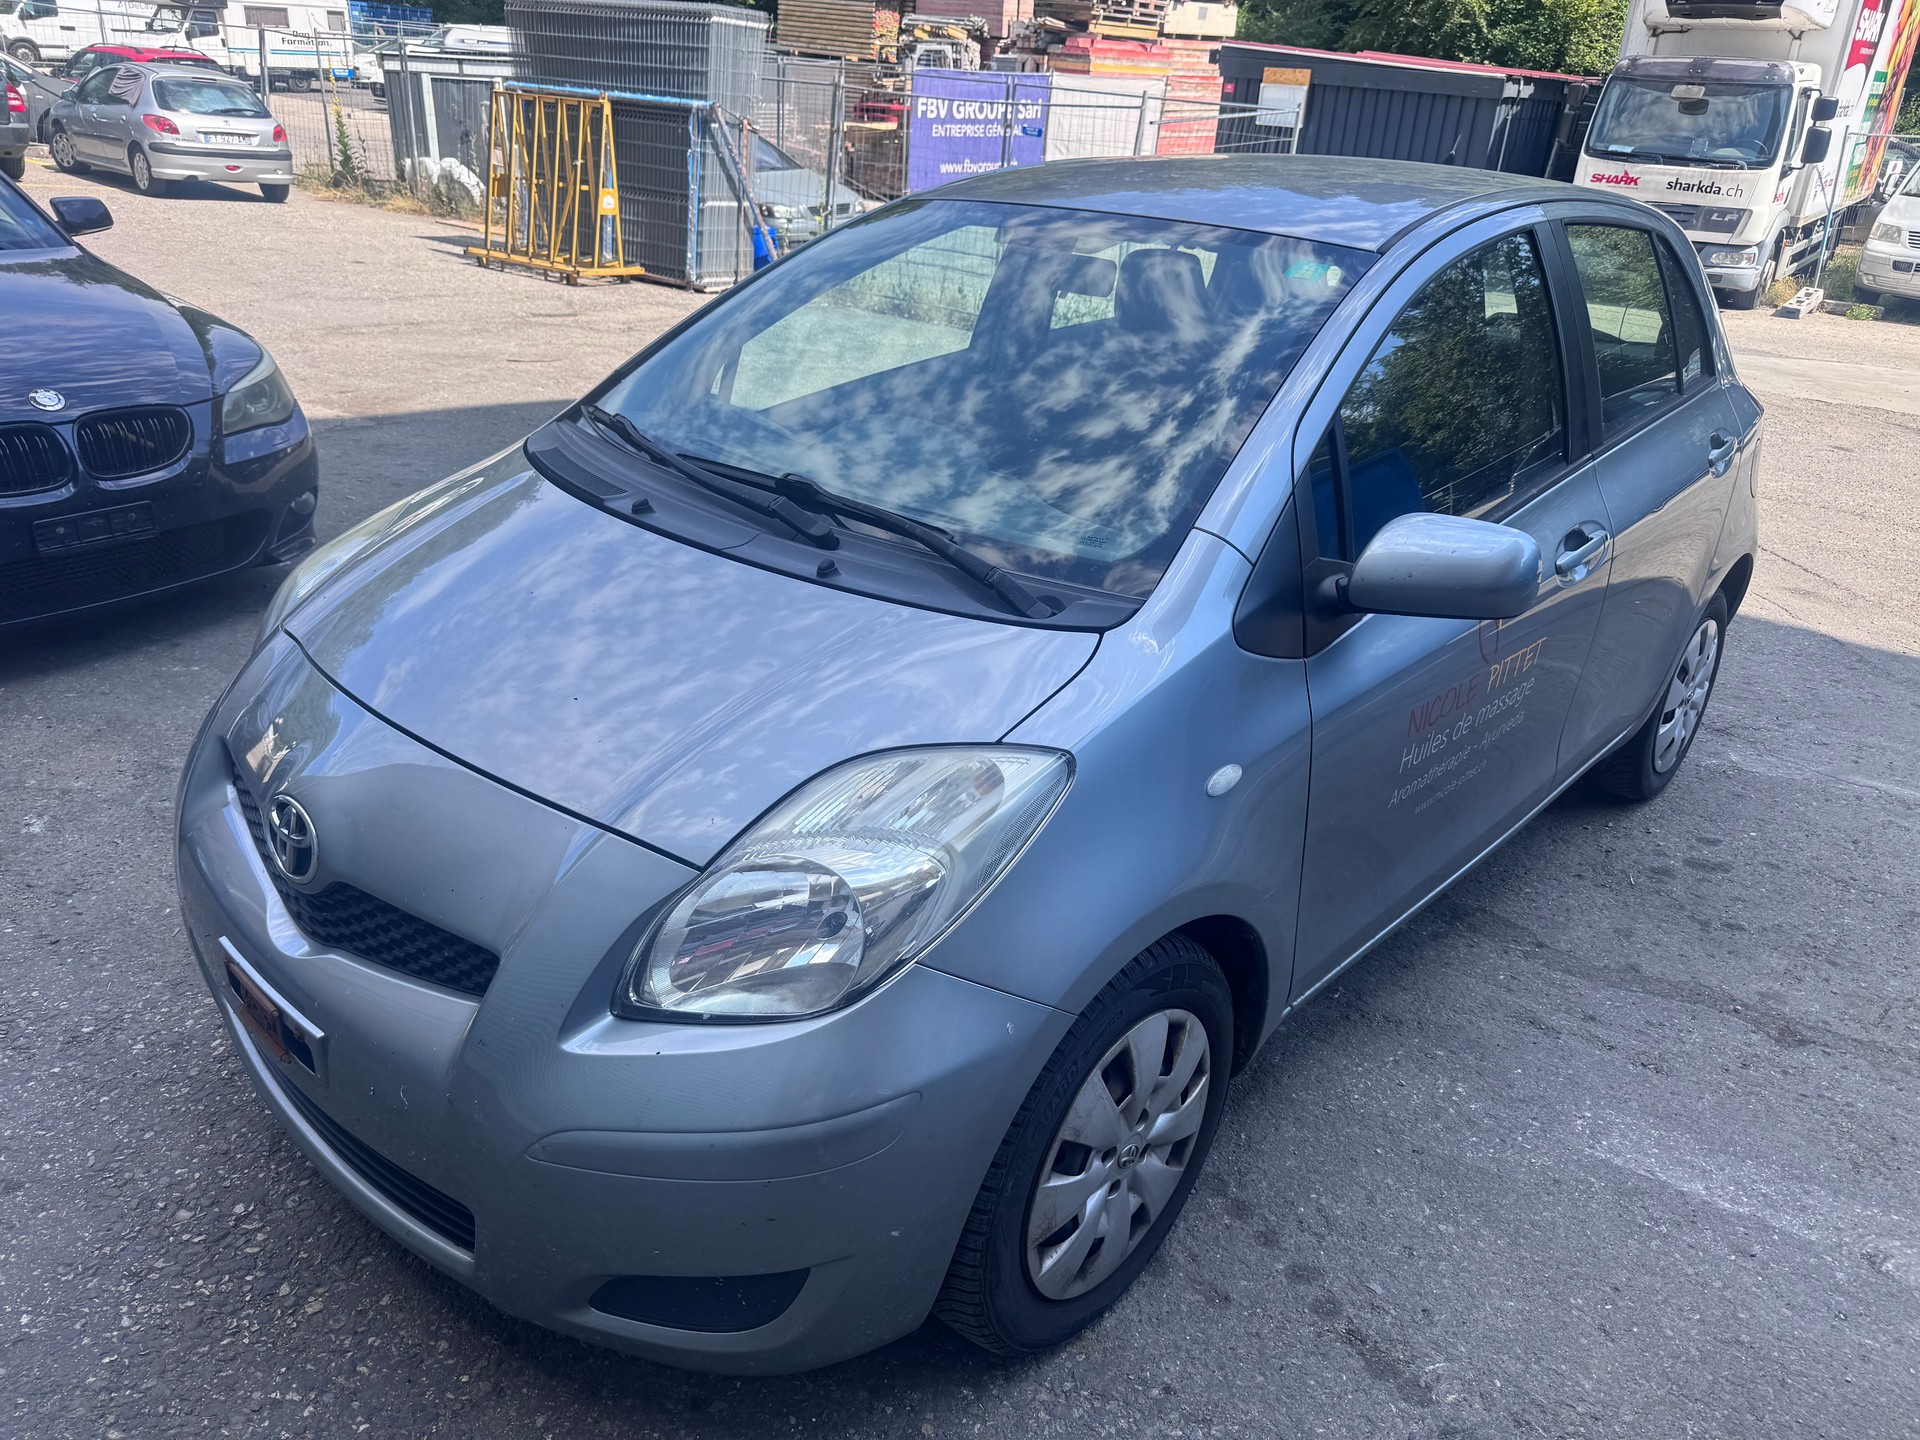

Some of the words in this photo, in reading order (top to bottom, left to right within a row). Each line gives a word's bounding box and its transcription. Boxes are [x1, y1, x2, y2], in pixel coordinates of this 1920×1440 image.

[917, 98, 949, 119] FBV
[932, 124, 985, 137] ENTREPRISE
[986, 122, 1027, 138] GÉNAL
[1590, 171, 1641, 186] SHARK
[1665, 177, 1744, 198] sharkda.ch
[1711, 212, 1740, 222] LF
[1408, 674, 1481, 738] NICOLE
[1487, 637, 1547, 693] PITTET
[1399, 729, 1450, 774] Huiles
[1452, 712, 1473, 741] de
[1475, 677, 1535, 727] massage
[1388, 745, 1471, 808] Aromathérapie
